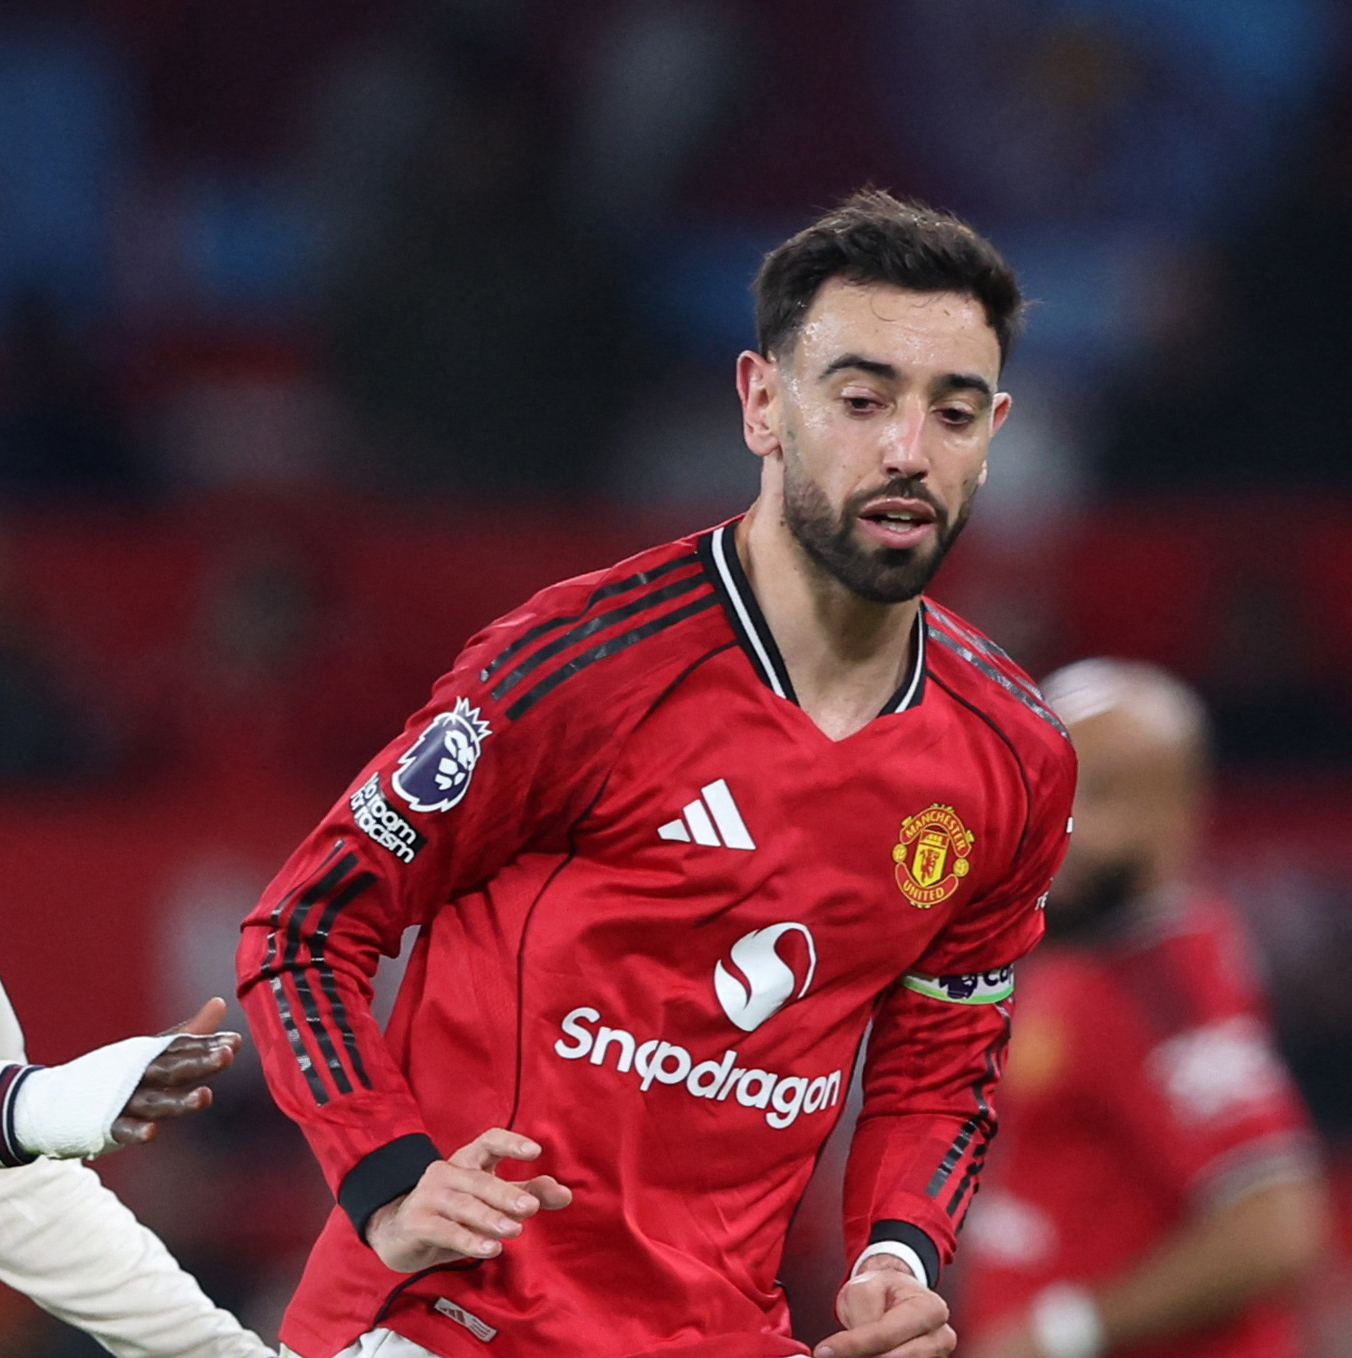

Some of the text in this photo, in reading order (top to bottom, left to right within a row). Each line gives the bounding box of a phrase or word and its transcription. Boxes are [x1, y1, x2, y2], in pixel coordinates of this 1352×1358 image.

[353, 805, 415, 864] racism
[366, 793, 417, 845] room
[905, 810, 967, 852] MANCHESTER
[902, 879, 945, 902] UNITED
